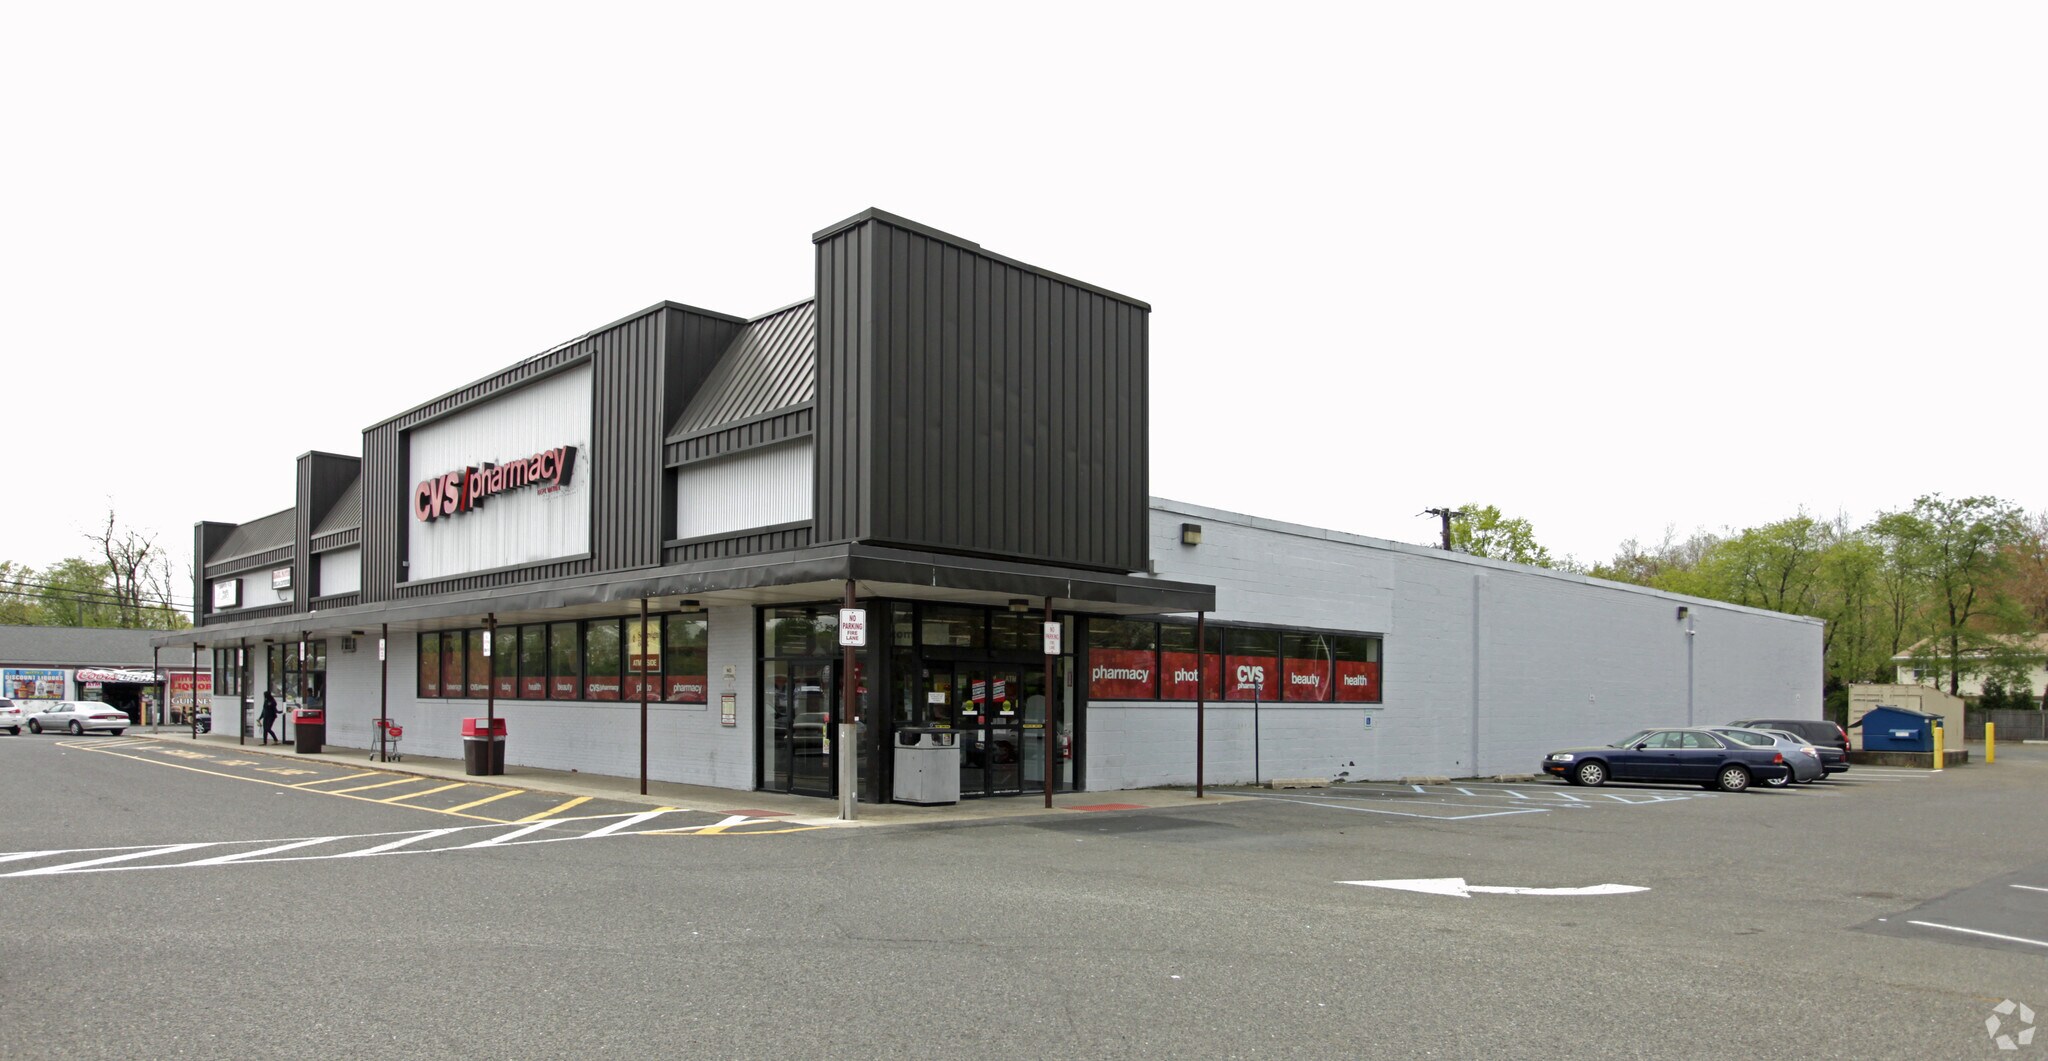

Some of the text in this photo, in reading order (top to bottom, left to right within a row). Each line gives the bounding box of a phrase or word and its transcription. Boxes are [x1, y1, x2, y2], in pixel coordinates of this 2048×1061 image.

[1092, 665, 1150, 683] pharmacy
[1174, 668, 1198, 684] phot
[1236, 665, 1264, 682] CVS
[1291, 672, 1320, 687] beauty
[1344, 674, 1368, 686] health
[673, 682, 703, 694] pharmacy
[1237, 682, 1264, 690] pharmcy
